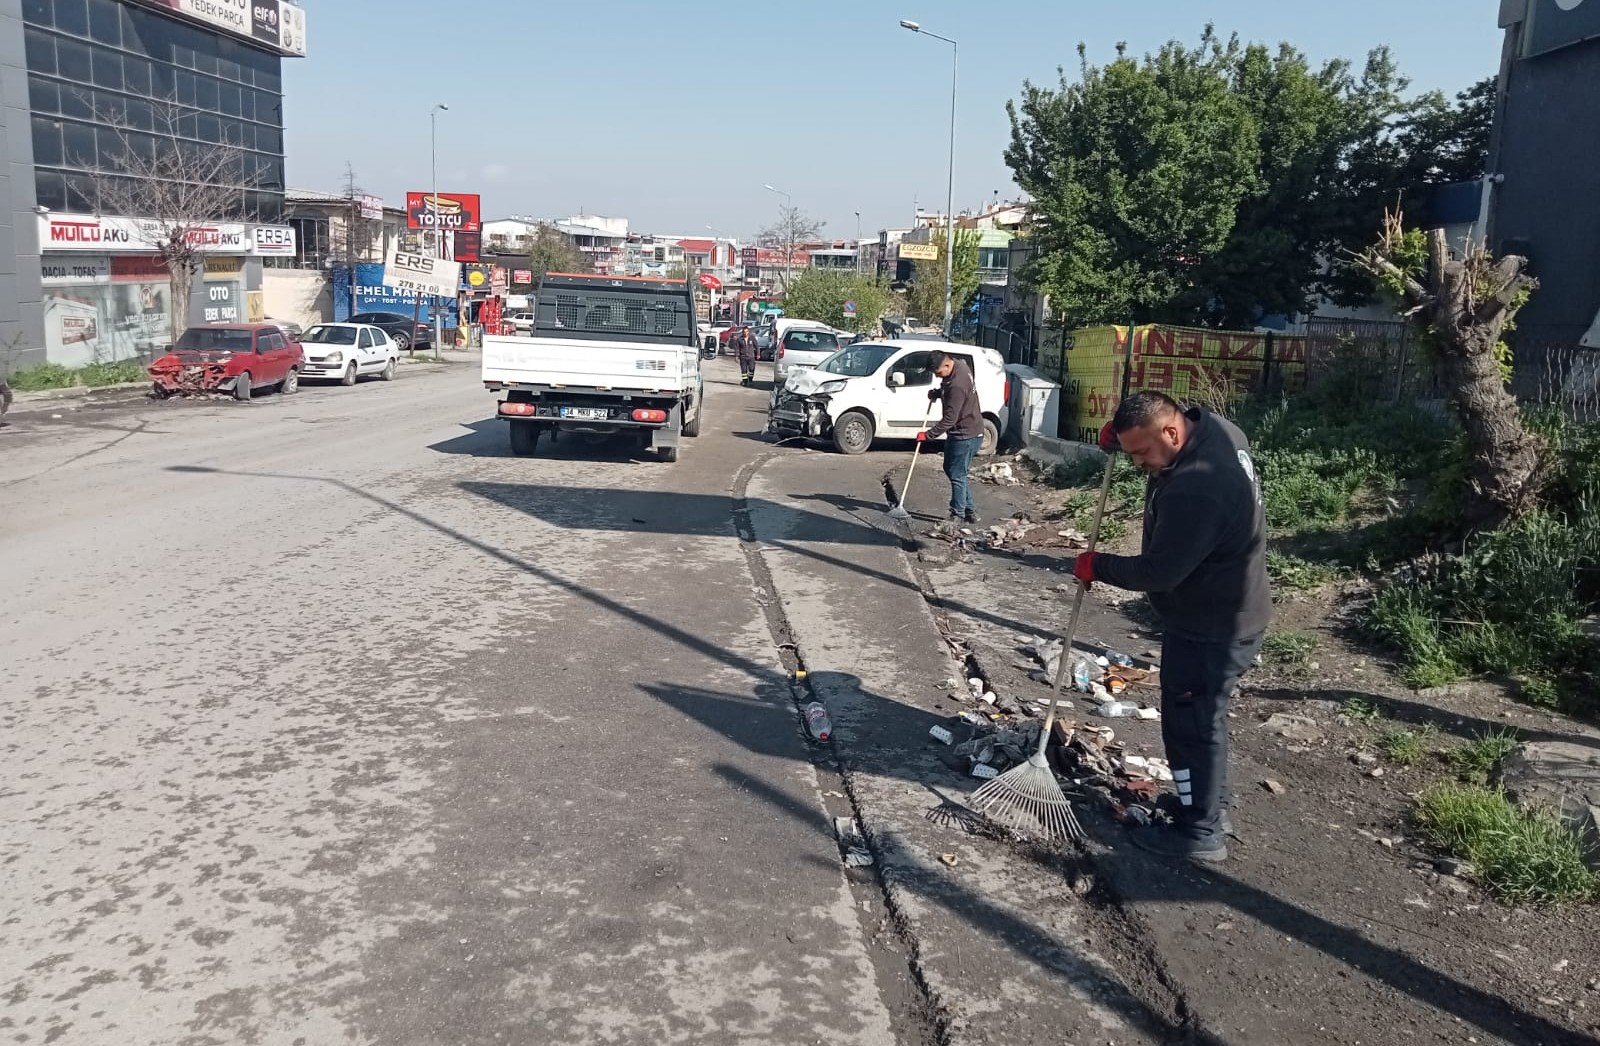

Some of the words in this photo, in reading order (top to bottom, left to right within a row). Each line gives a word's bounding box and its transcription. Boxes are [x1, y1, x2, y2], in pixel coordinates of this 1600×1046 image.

[190, 0, 217, 17] YEDEK
[51, 221, 101, 242] MUTLU
[103, 228, 129, 242] AKÜ
[256, 228, 292, 244] ERSA
[394, 253, 434, 271] ERS
[42, 266, 66, 278] DACIA
[210, 286, 228, 300] OTO
[346, 285, 389, 296] TEMEL
[399, 280, 414, 289] 278
[417, 283, 426, 291] 21
